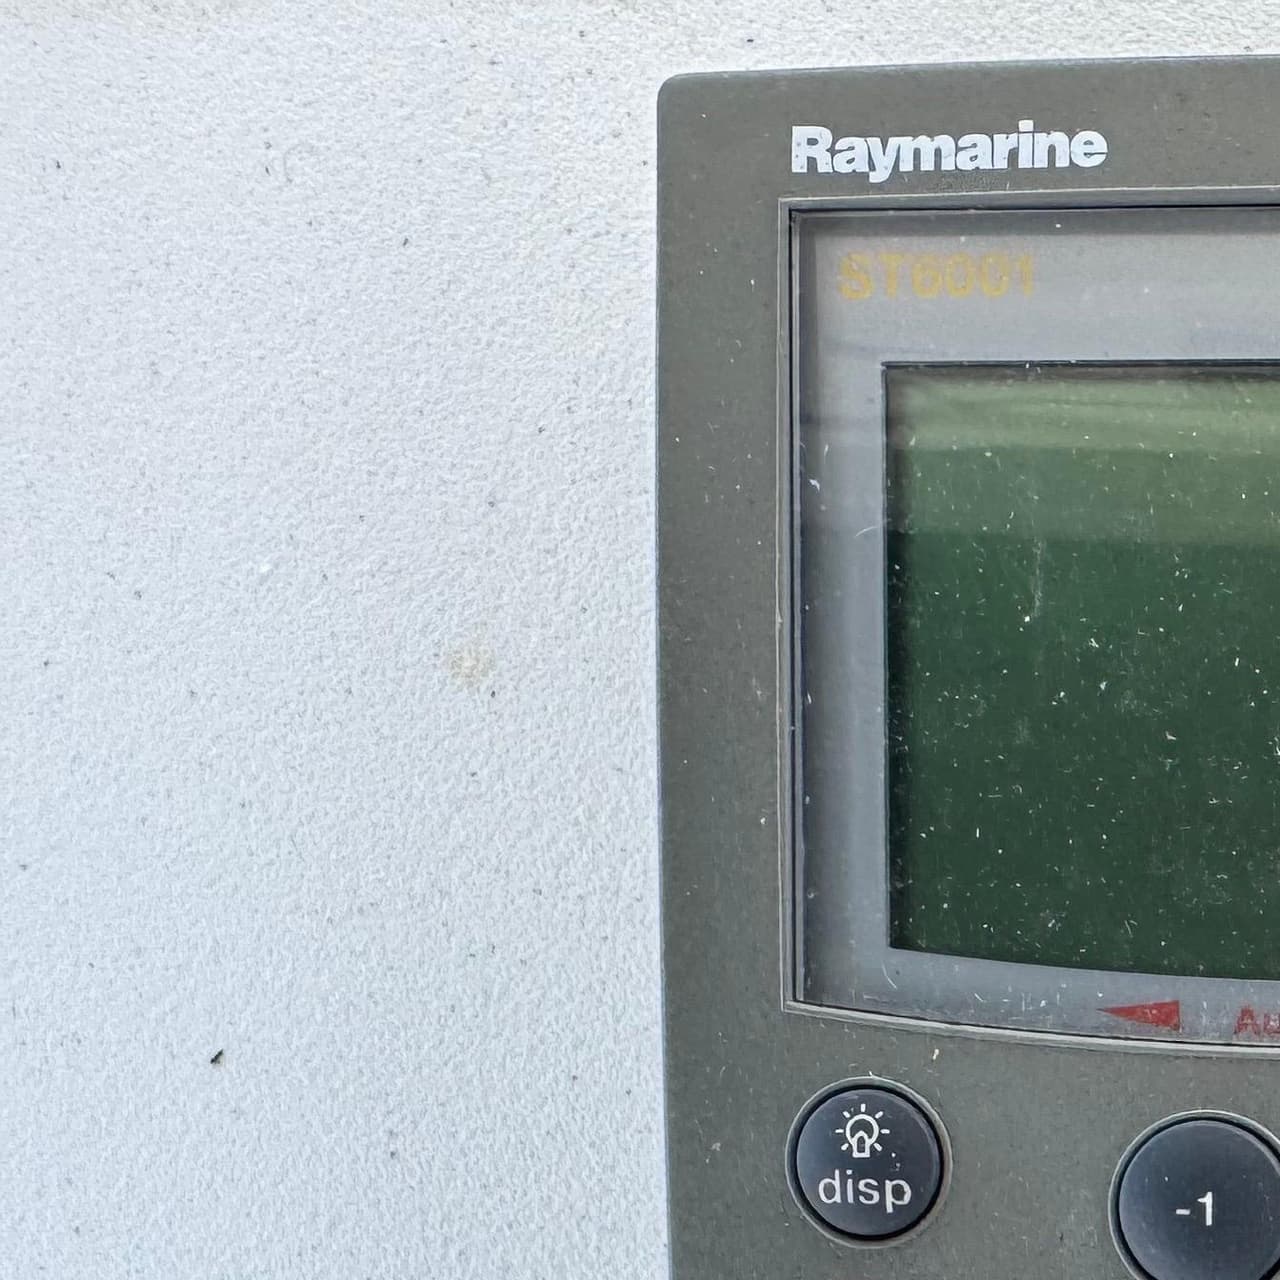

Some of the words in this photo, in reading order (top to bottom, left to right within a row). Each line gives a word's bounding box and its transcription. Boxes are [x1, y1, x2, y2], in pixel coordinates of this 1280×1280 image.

[791, 120, 1107, 183] Raymarine
[818, 1168, 912, 1214] disp
[1175, 1191, 1214, 1227] -1
